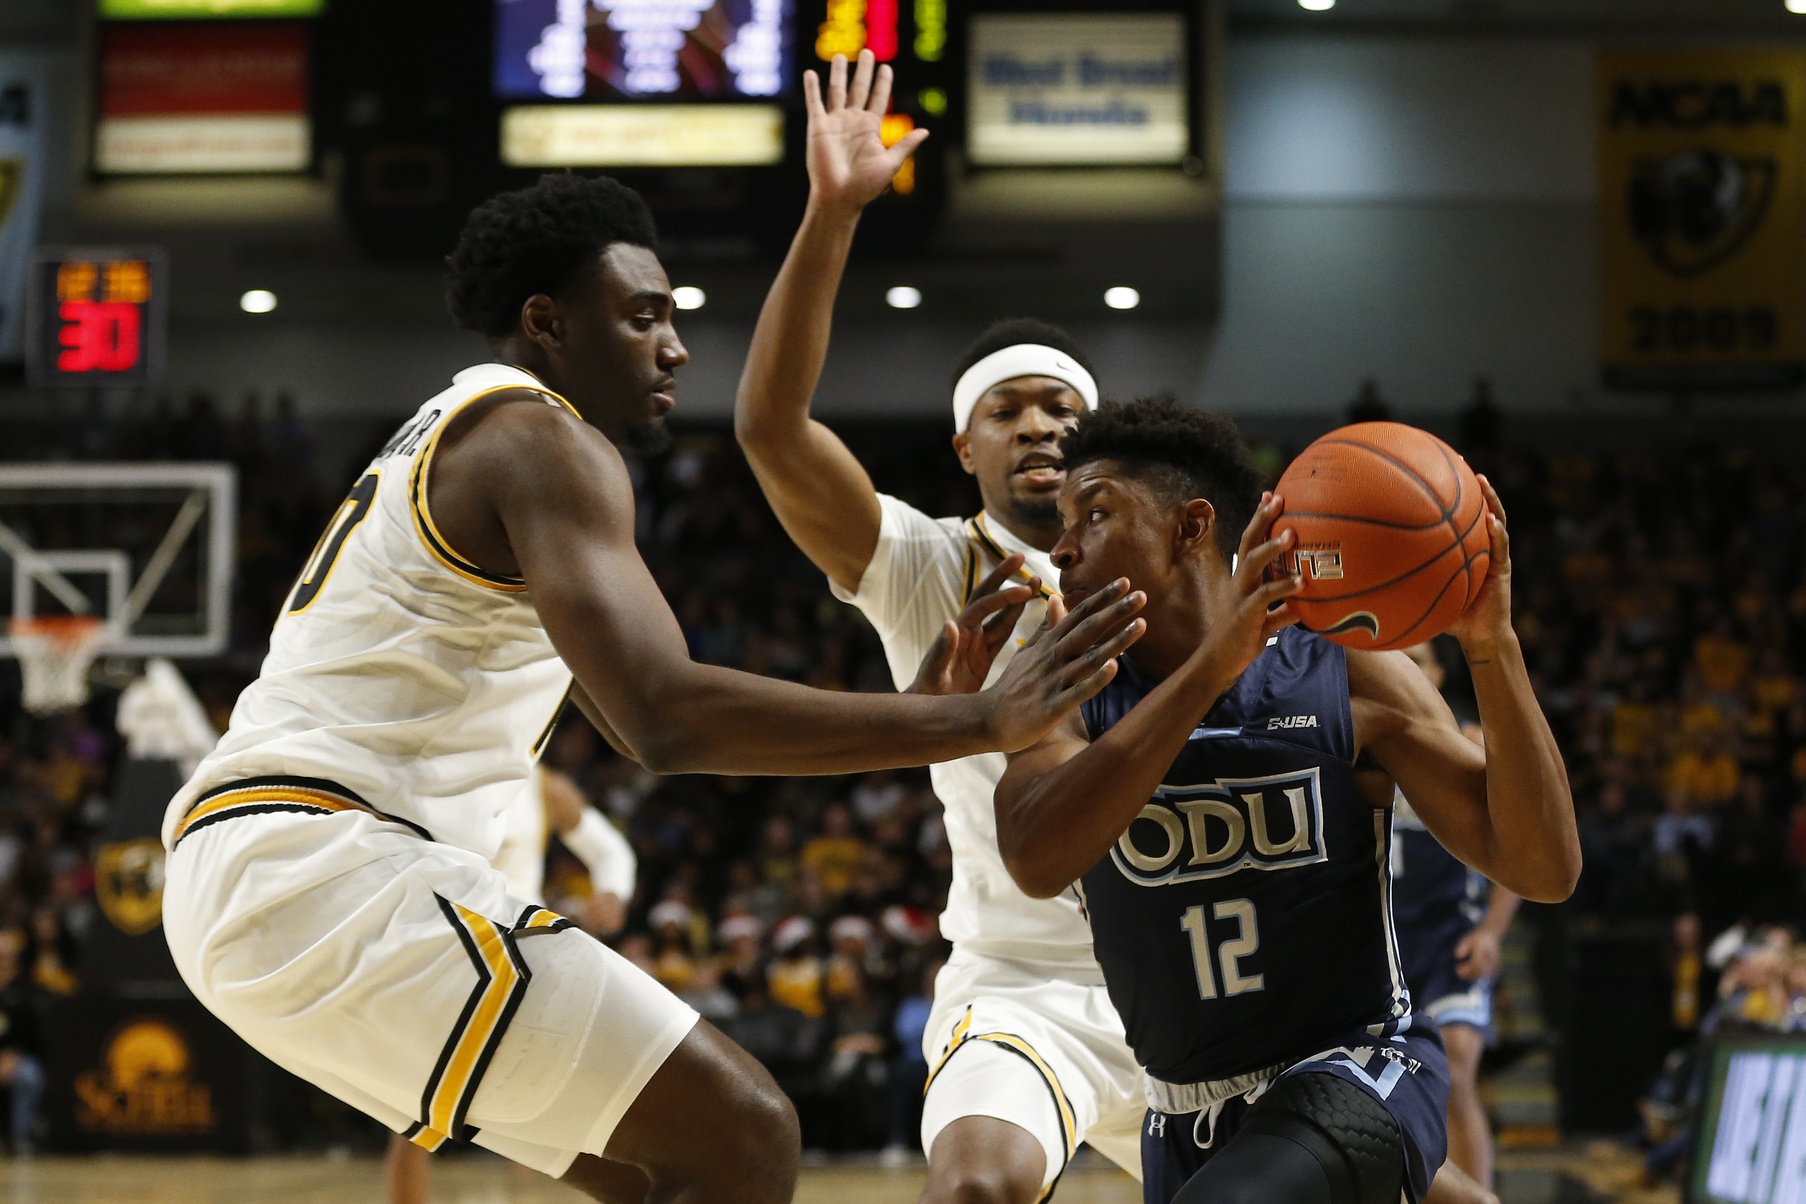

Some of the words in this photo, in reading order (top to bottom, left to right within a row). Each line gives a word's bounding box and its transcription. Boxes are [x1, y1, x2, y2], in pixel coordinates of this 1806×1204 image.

[1609, 79, 1790, 129] NCAA
[57, 301, 140, 372] 30
[1628, 306, 1778, 352] 2009
[1120, 785, 1312, 872] ODU
[1179, 897, 1265, 1000] 12
